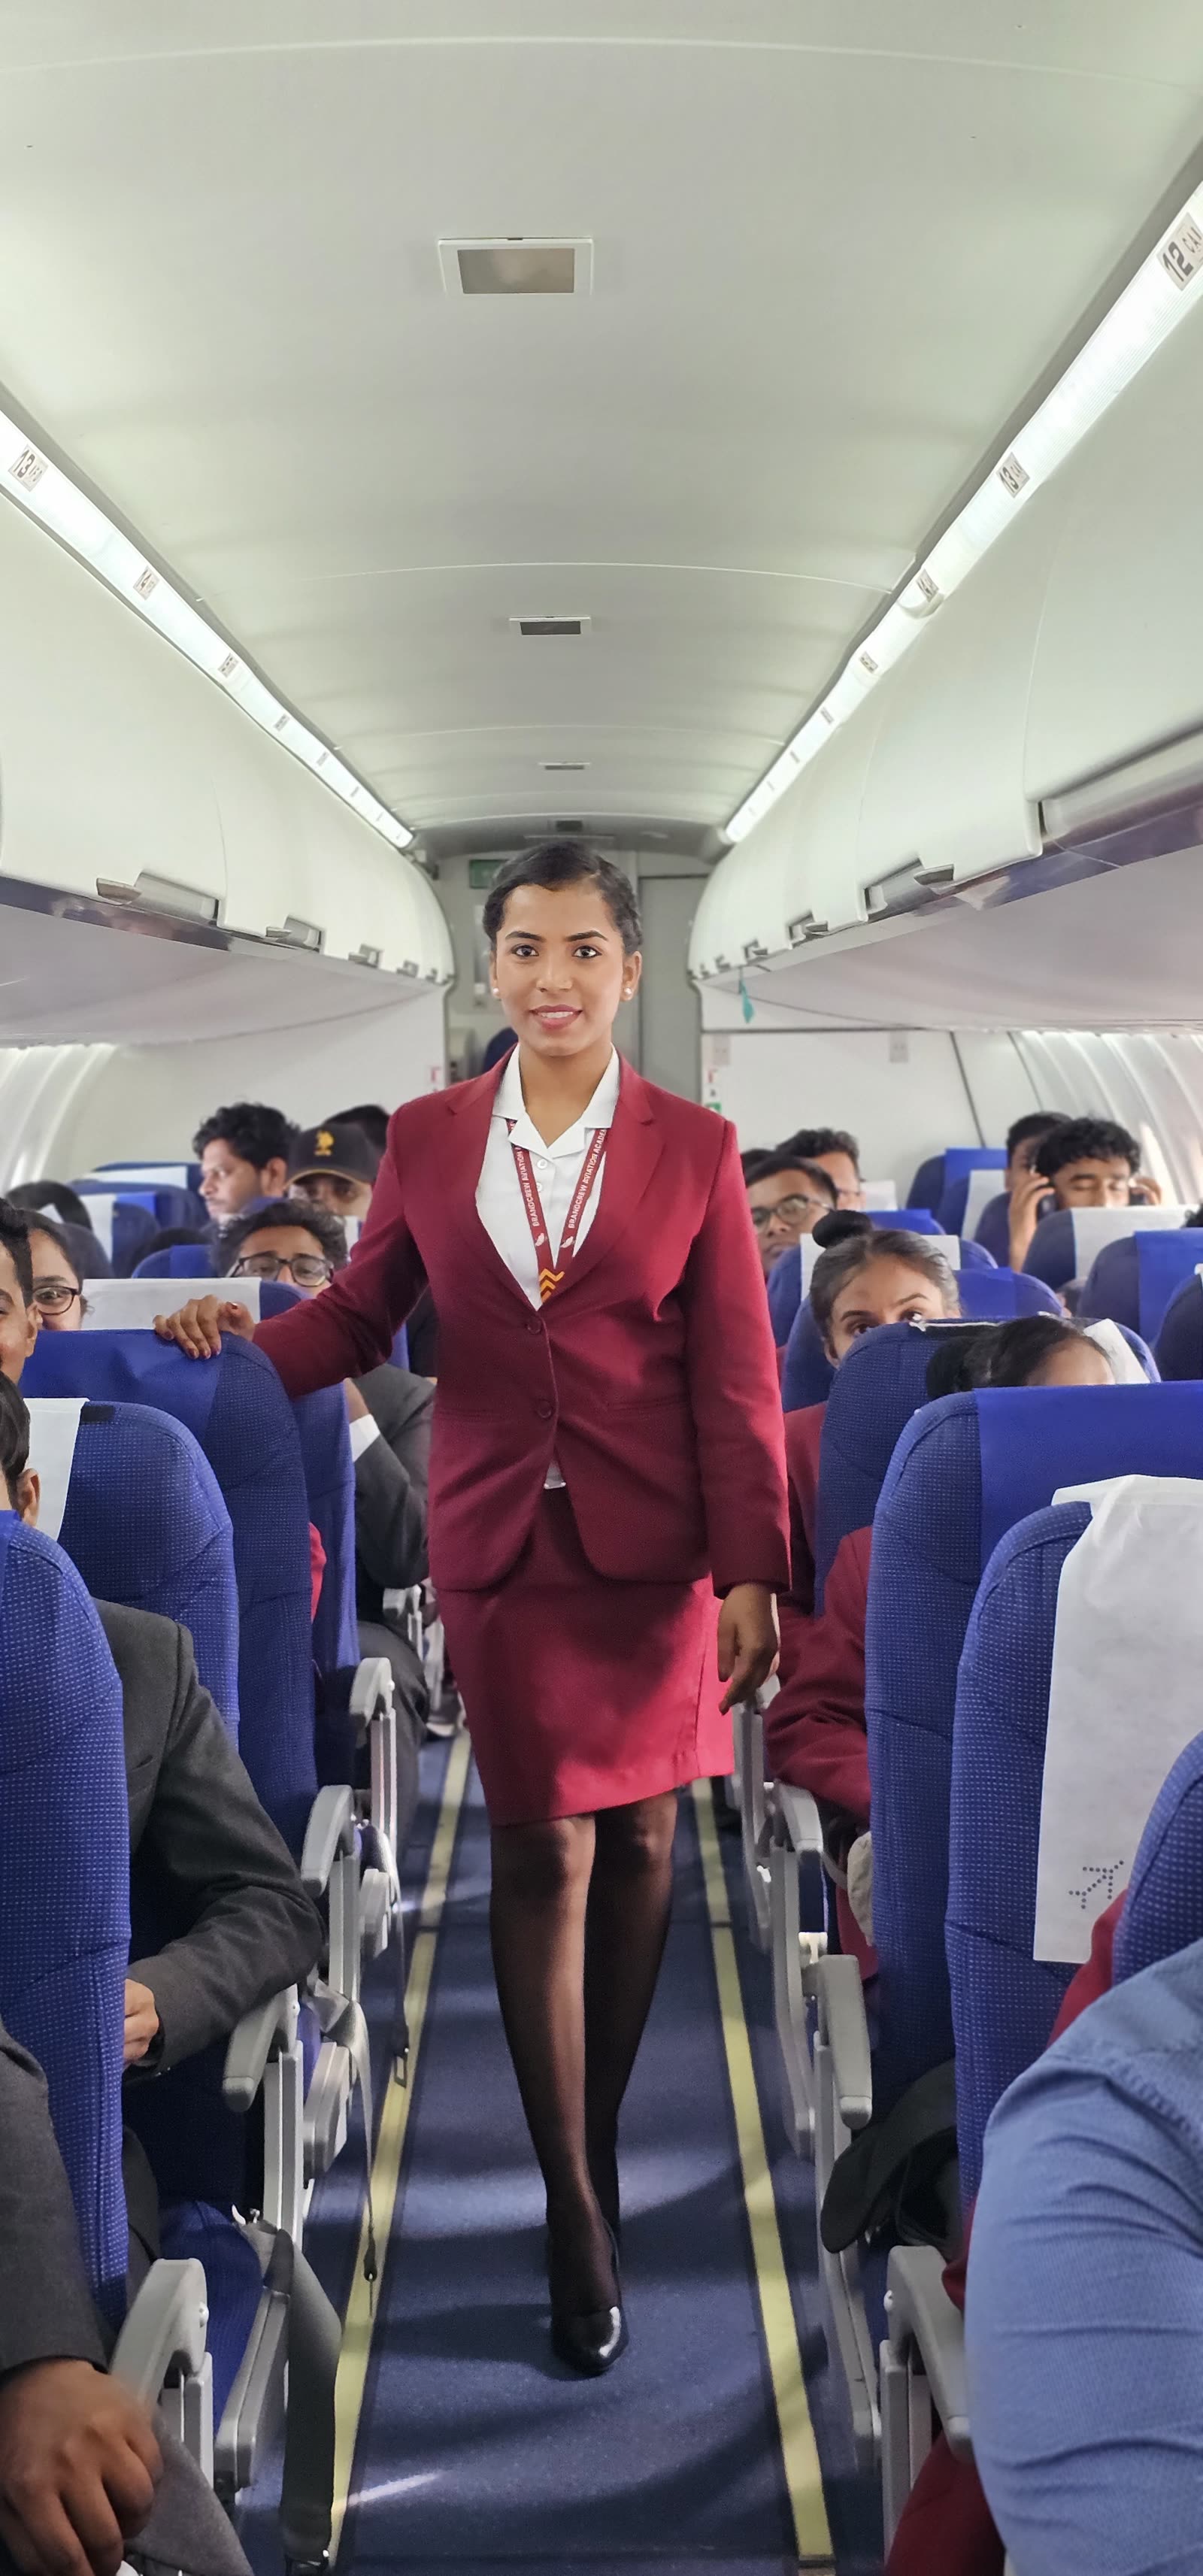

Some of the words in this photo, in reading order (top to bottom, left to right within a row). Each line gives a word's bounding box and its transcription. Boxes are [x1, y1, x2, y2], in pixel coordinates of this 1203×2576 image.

[1162, 241, 1194, 282] 12
[13, 449, 35, 478] 13
[998, 466, 1019, 494] 13
[517, 1150, 529, 1181] AVIATION
[582, 1153, 598, 1184] AVIATION
